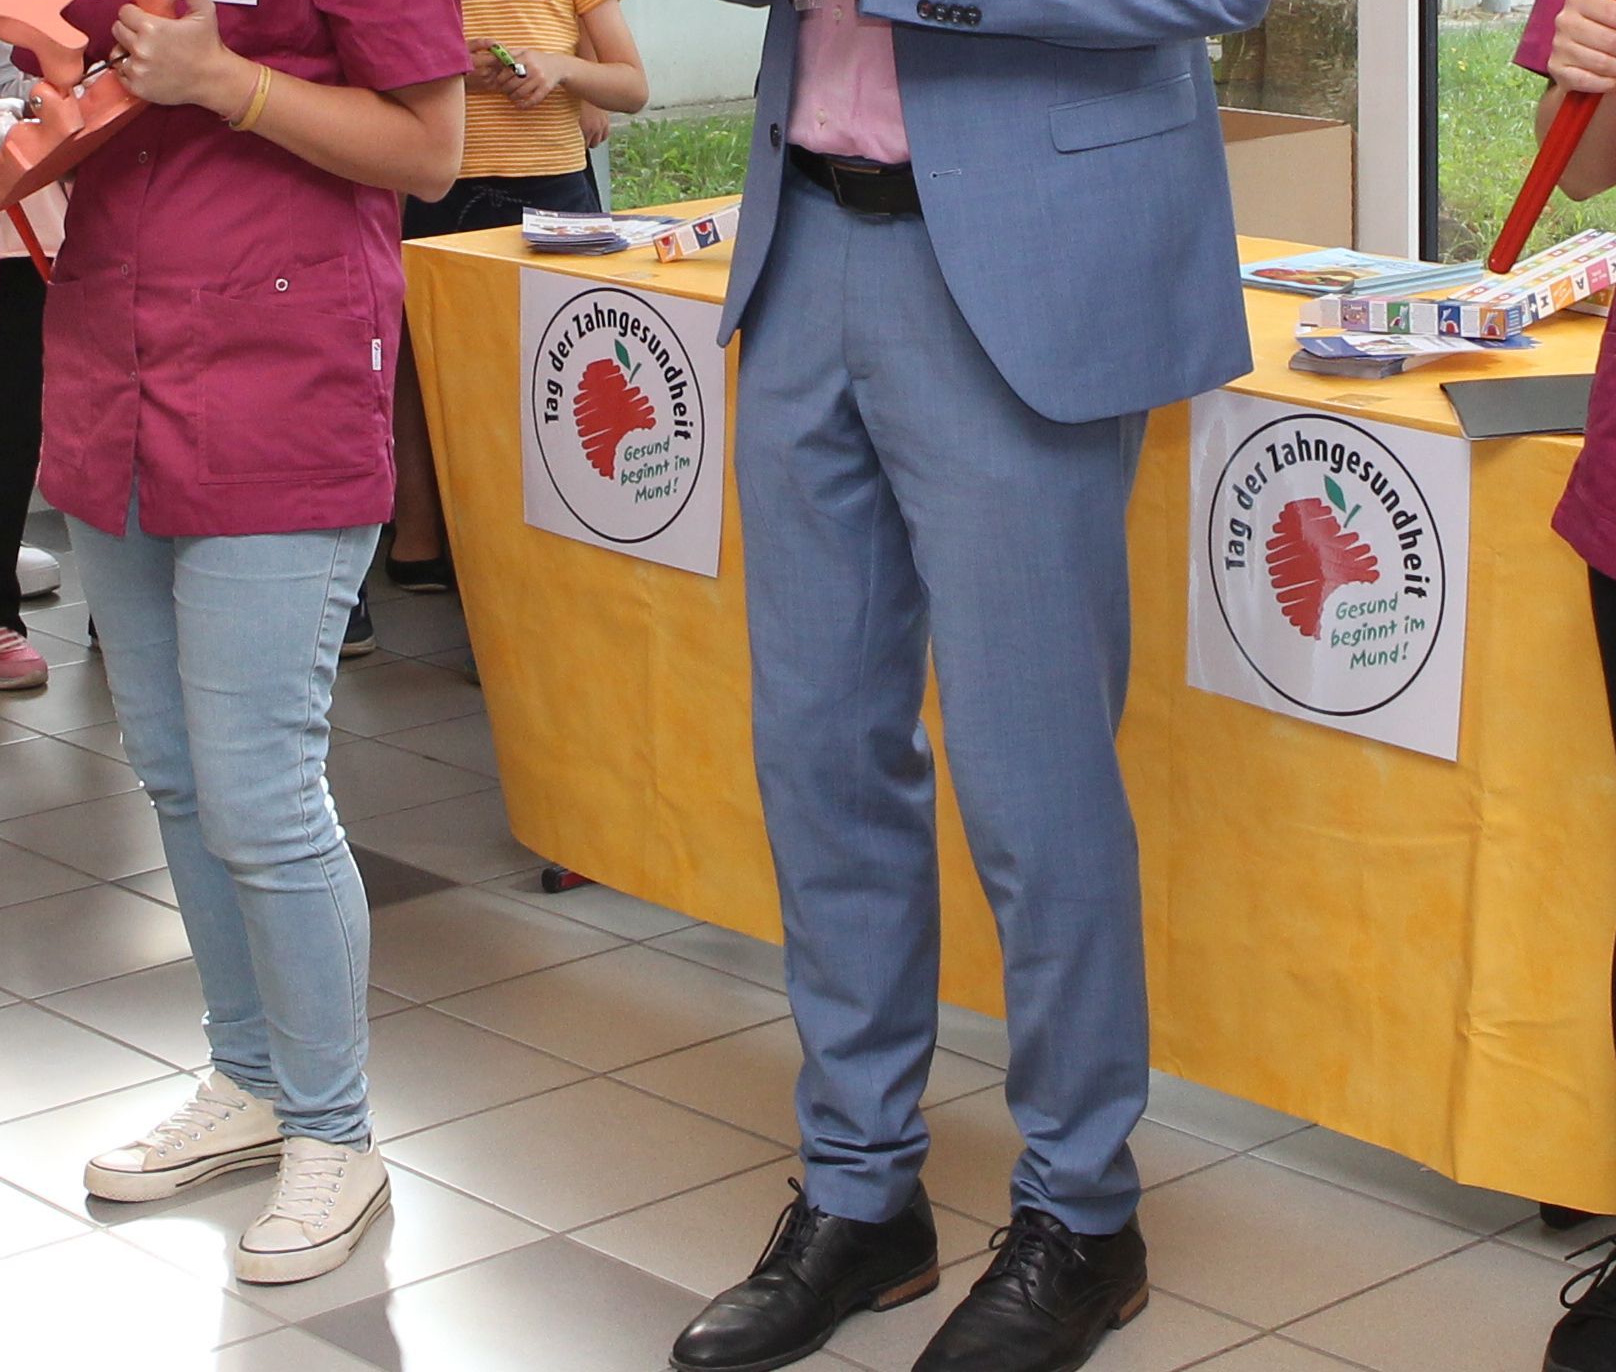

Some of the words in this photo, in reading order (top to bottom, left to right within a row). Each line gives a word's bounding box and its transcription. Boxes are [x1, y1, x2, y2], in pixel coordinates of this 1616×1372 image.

[548, 330, 575, 373] der
[572, 302, 694, 441] Zahngesundheit
[544, 379, 563, 424] Tag
[624, 435, 670, 462] Gesund
[620, 461, 670, 486] beginnt
[674, 455, 690, 471] im
[1232, 462, 1268, 510] der
[634, 477, 680, 503] Mund!
[1265, 430, 1430, 599] Zahngesundheit
[1225, 517, 1252, 571] Tag
[1335, 592, 1399, 620] Gesund
[1330, 619, 1397, 648] beginnt
[1404, 615, 1425, 634] im
[1349, 641, 1409, 669] Mund!
